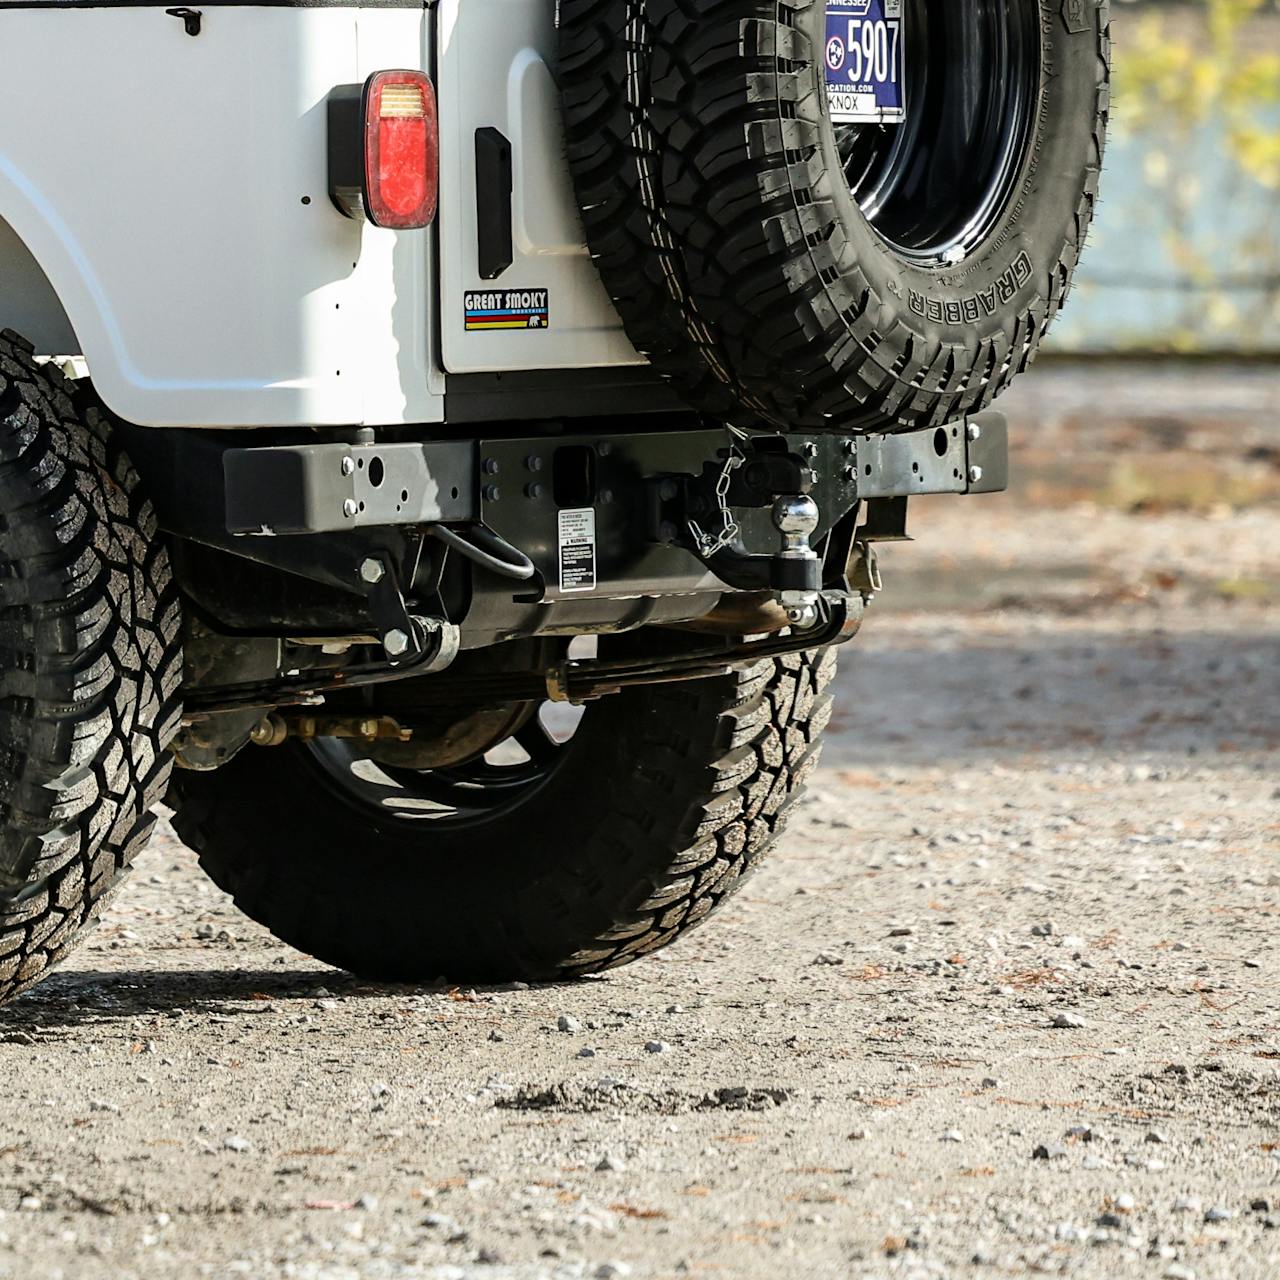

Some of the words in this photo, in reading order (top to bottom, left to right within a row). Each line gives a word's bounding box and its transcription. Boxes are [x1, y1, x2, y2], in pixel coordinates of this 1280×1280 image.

[847, 19, 900, 83] 5907
[826, 83, 874, 93] ACATION.COM
[829, 94, 859, 111] KNOX
[908, 249, 1034, 325] GRABBER
[465, 294, 502, 310] GREAT
[505, 292, 546, 308] SMOKY
